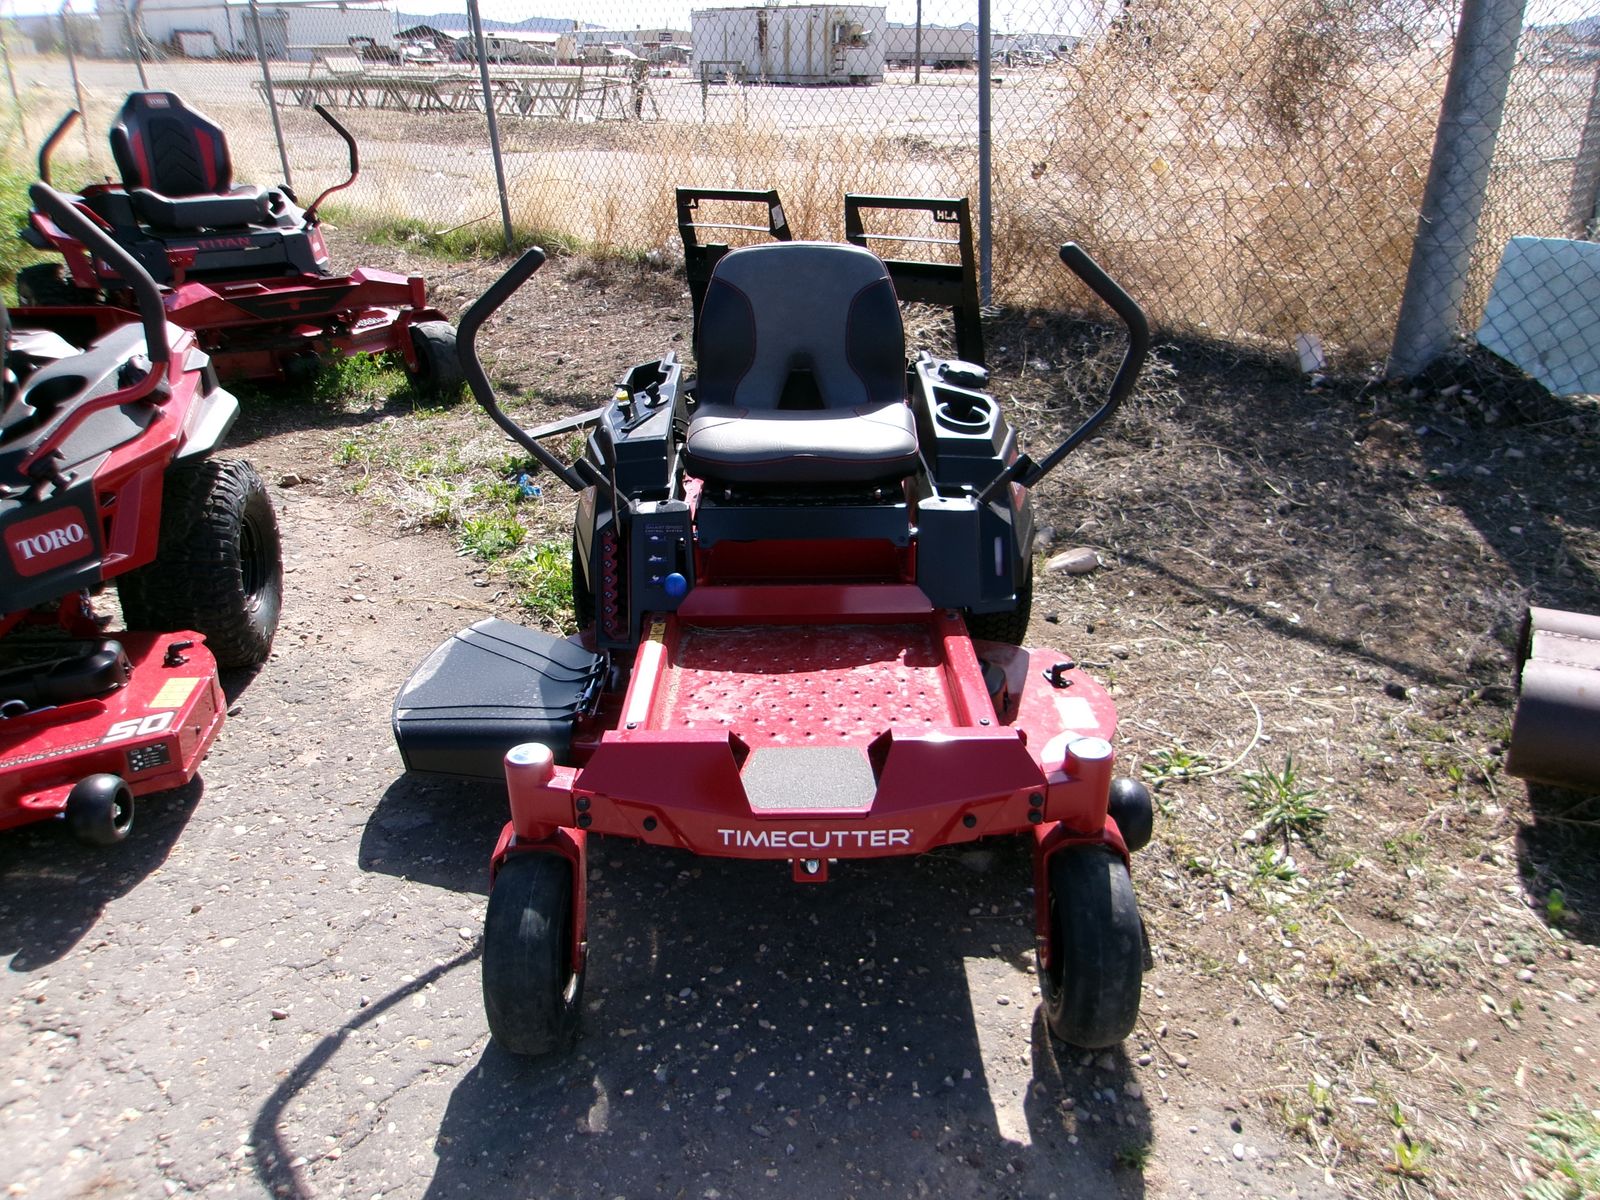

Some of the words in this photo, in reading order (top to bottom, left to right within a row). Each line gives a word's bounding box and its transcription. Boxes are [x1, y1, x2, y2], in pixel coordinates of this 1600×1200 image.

[937, 210, 958, 220] HLA
[198, 237, 250, 249] TITAN
[16, 523, 84, 560] TORO
[102, 711, 174, 743] 50
[717, 829, 910, 847] TIMECUTTER
